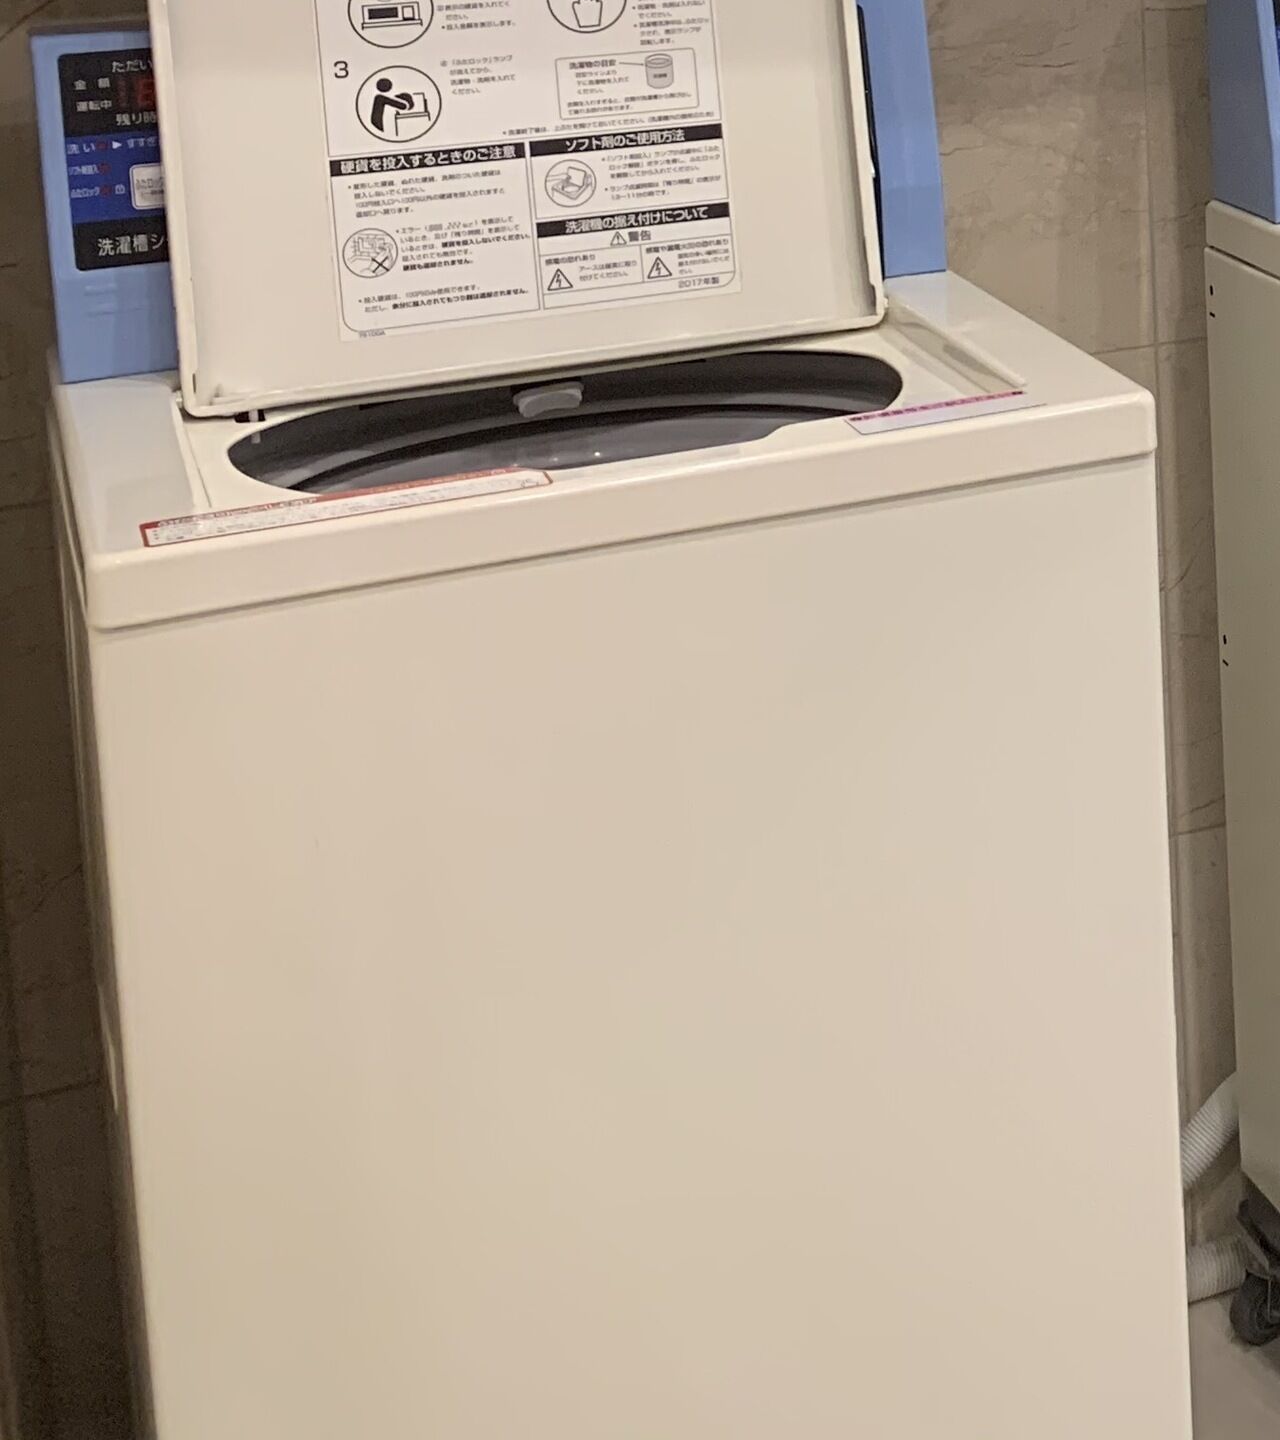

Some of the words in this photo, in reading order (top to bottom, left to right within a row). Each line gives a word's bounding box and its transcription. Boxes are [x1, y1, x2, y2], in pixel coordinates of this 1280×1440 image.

[333, 60, 350, 78] 3
[75, 99, 113, 113] 運転中
[66, 140, 96, 154] 洗い
[565, 128, 686, 152] ソフト剤のご使用方法
[340, 144, 517, 174] 硬貨を投入するときのご注意
[565, 206, 710, 234] 洗濯機の据え付けについて
[97, 233, 165, 257] 洗濯槽シ
[627, 230, 652, 242] 警告
